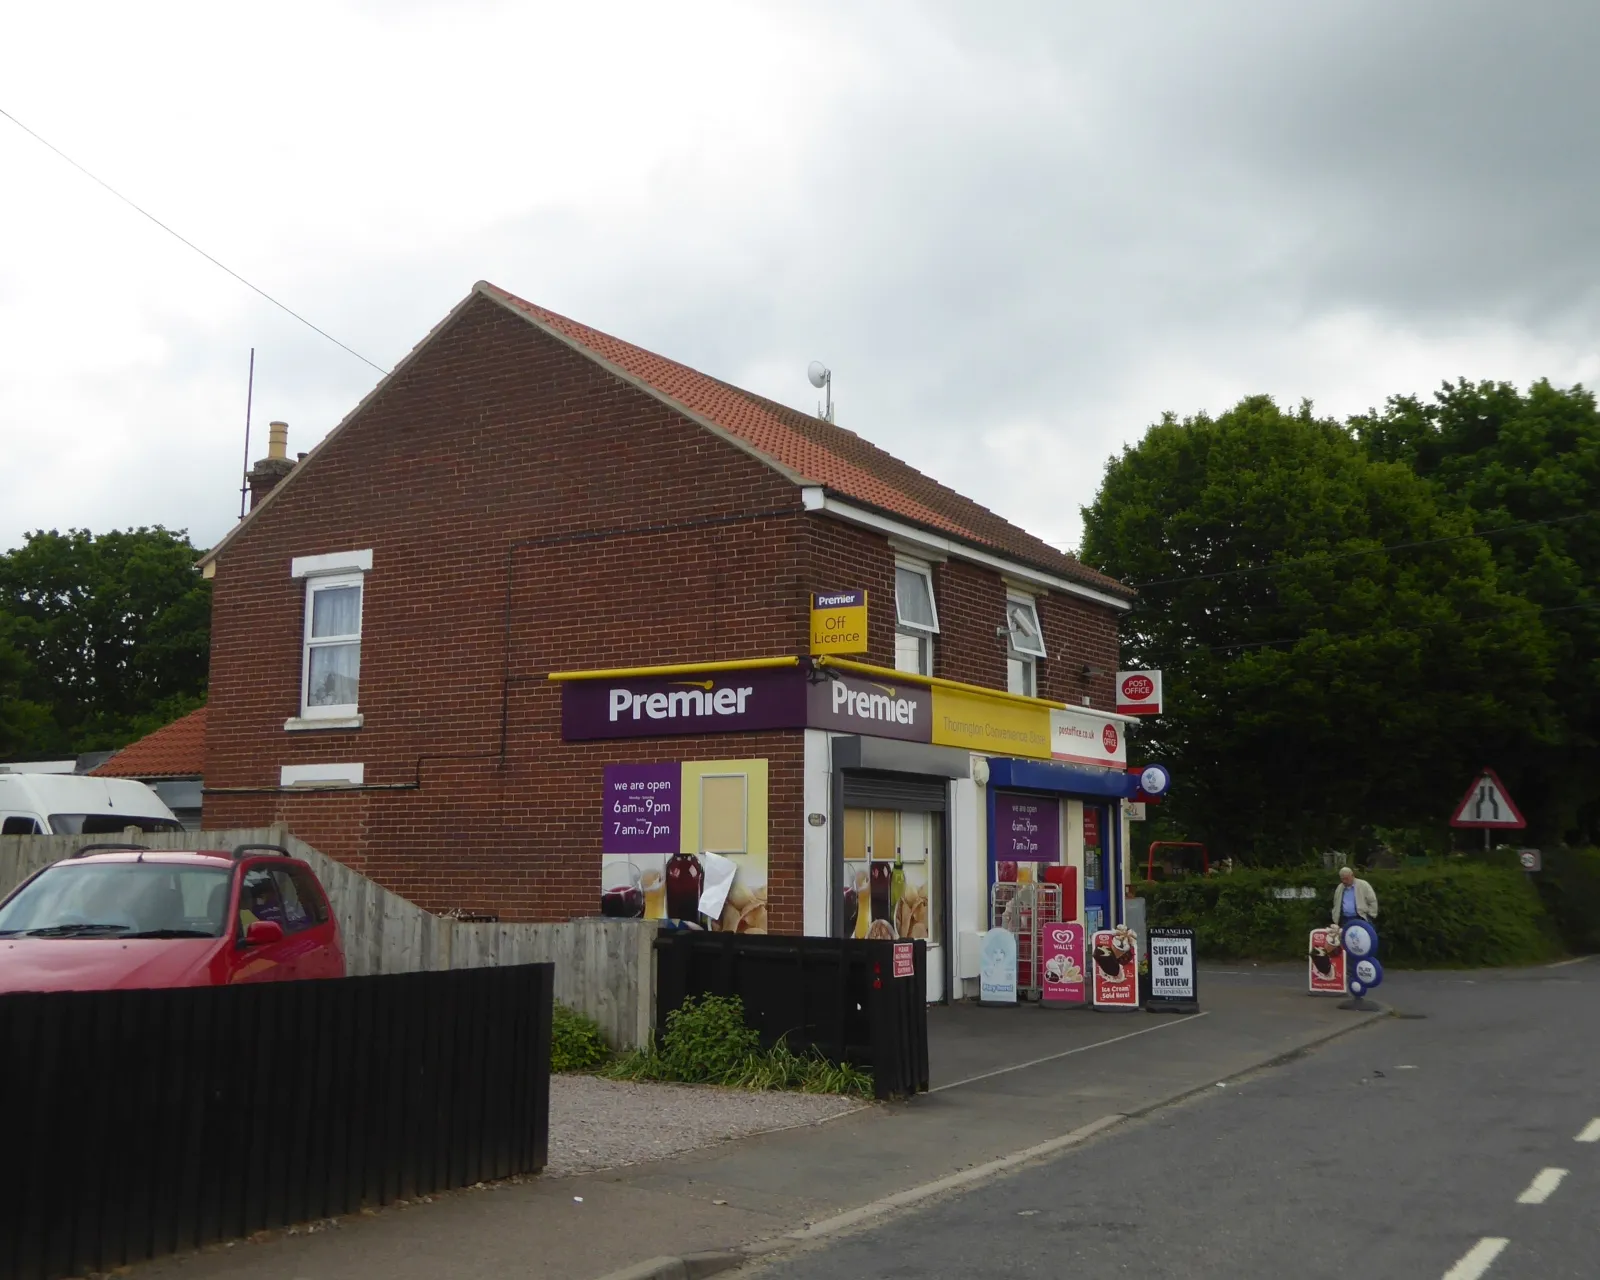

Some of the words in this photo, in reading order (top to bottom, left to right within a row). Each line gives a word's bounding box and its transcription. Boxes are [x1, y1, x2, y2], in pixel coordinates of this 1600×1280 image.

[818, 594, 856, 606] Premier
[825, 616, 846, 630] Off
[814, 632, 860, 644] Licence
[1124, 687, 1150, 695] OFFICE
[609, 680, 753, 722] Premier
[832, 681, 917, 725] Premier
[943, 716, 984, 738] Thorrington
[985, 724, 1028, 743] Convenience
[1058, 726, 1095, 740] postoffice.co.uk
[1105, 730, 1115, 738] POST
[1104, 738, 1117, 747] OFFICE
[630, 782, 645, 790] are
[647, 781, 671, 793] open
[613, 800, 637, 813] 6am
[645, 799, 671, 816] 9pm
[1027, 806, 1037, 815] open
[613, 822, 637, 835] 7am
[645, 822, 670, 838] 7pm
[1153, 946, 1188, 955] SUFFOLK
[1158, 957, 1184, 966] SHOW
[1164, 967, 1179, 977] BIG
[1155, 978, 1189, 987] PREVIEW
